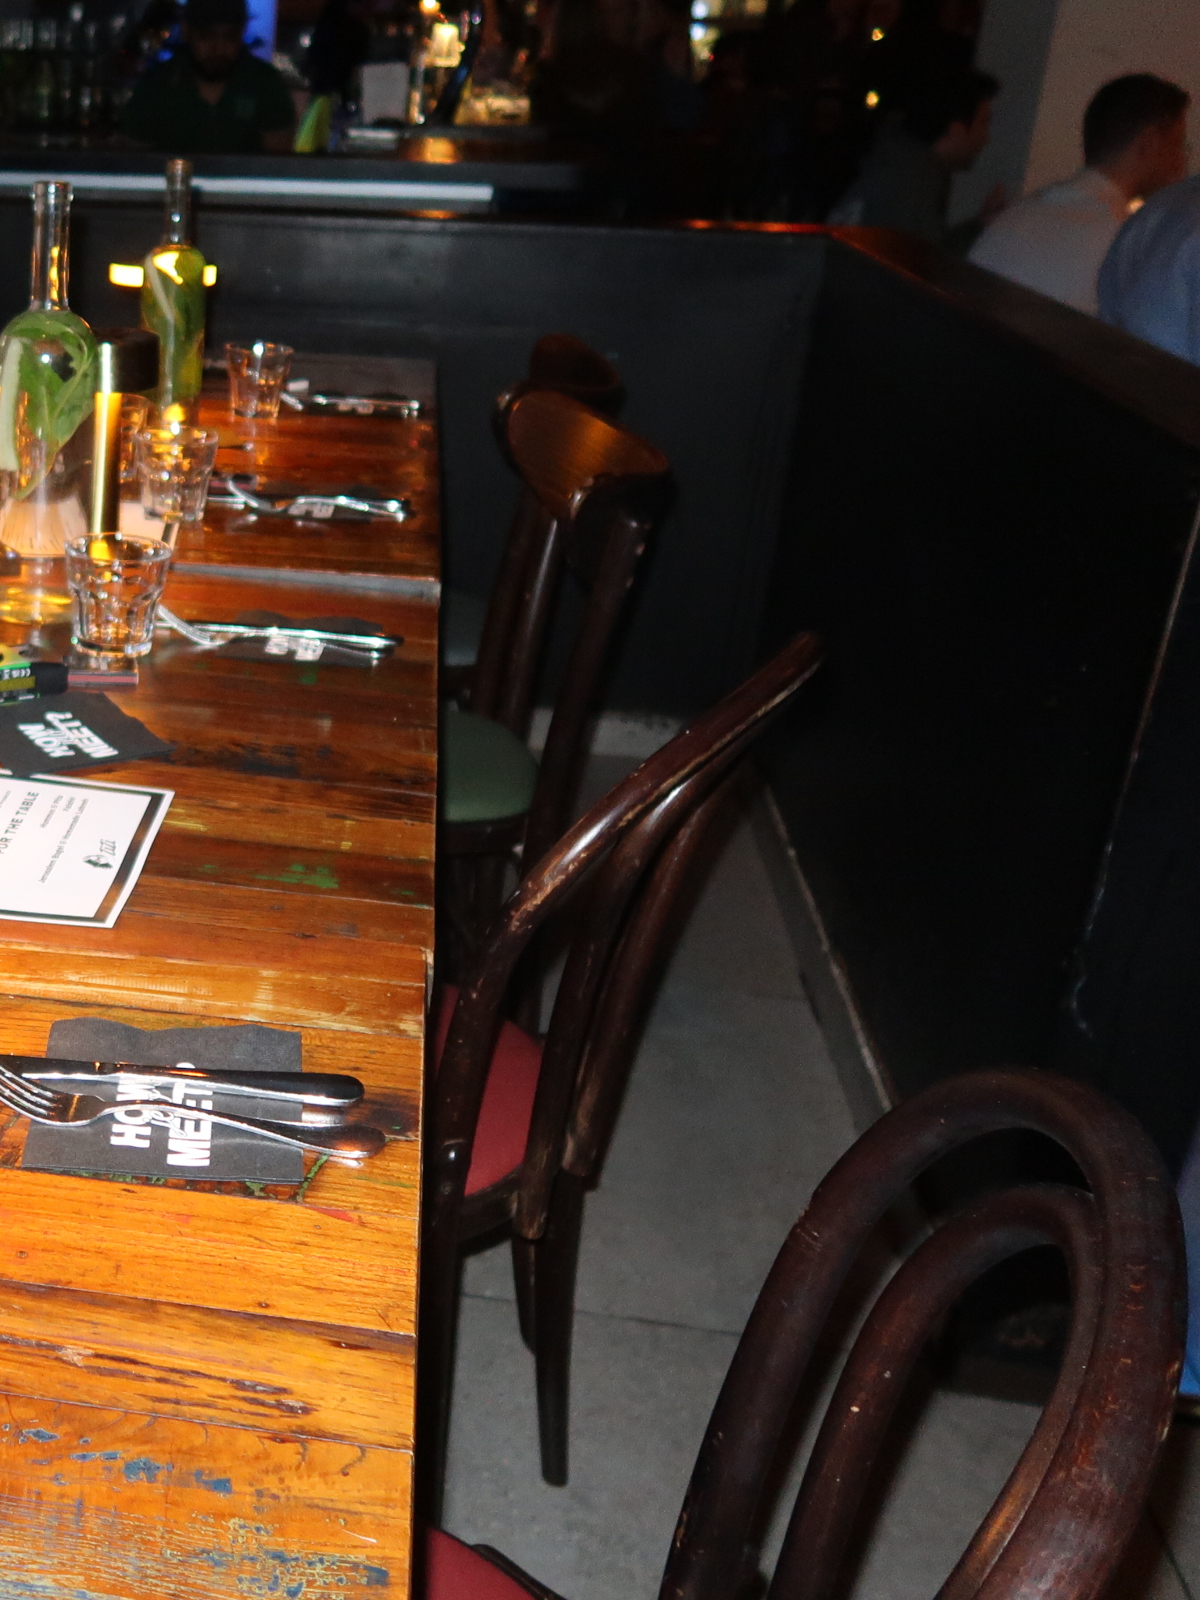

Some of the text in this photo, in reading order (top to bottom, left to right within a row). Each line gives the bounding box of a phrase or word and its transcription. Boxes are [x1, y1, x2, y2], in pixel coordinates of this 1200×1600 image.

[17, 722, 76, 757] HOW
[45, 711, 119, 758] MEET?
[4, 818, 23, 835] THE
[15, 791, 39, 815] TABLE
